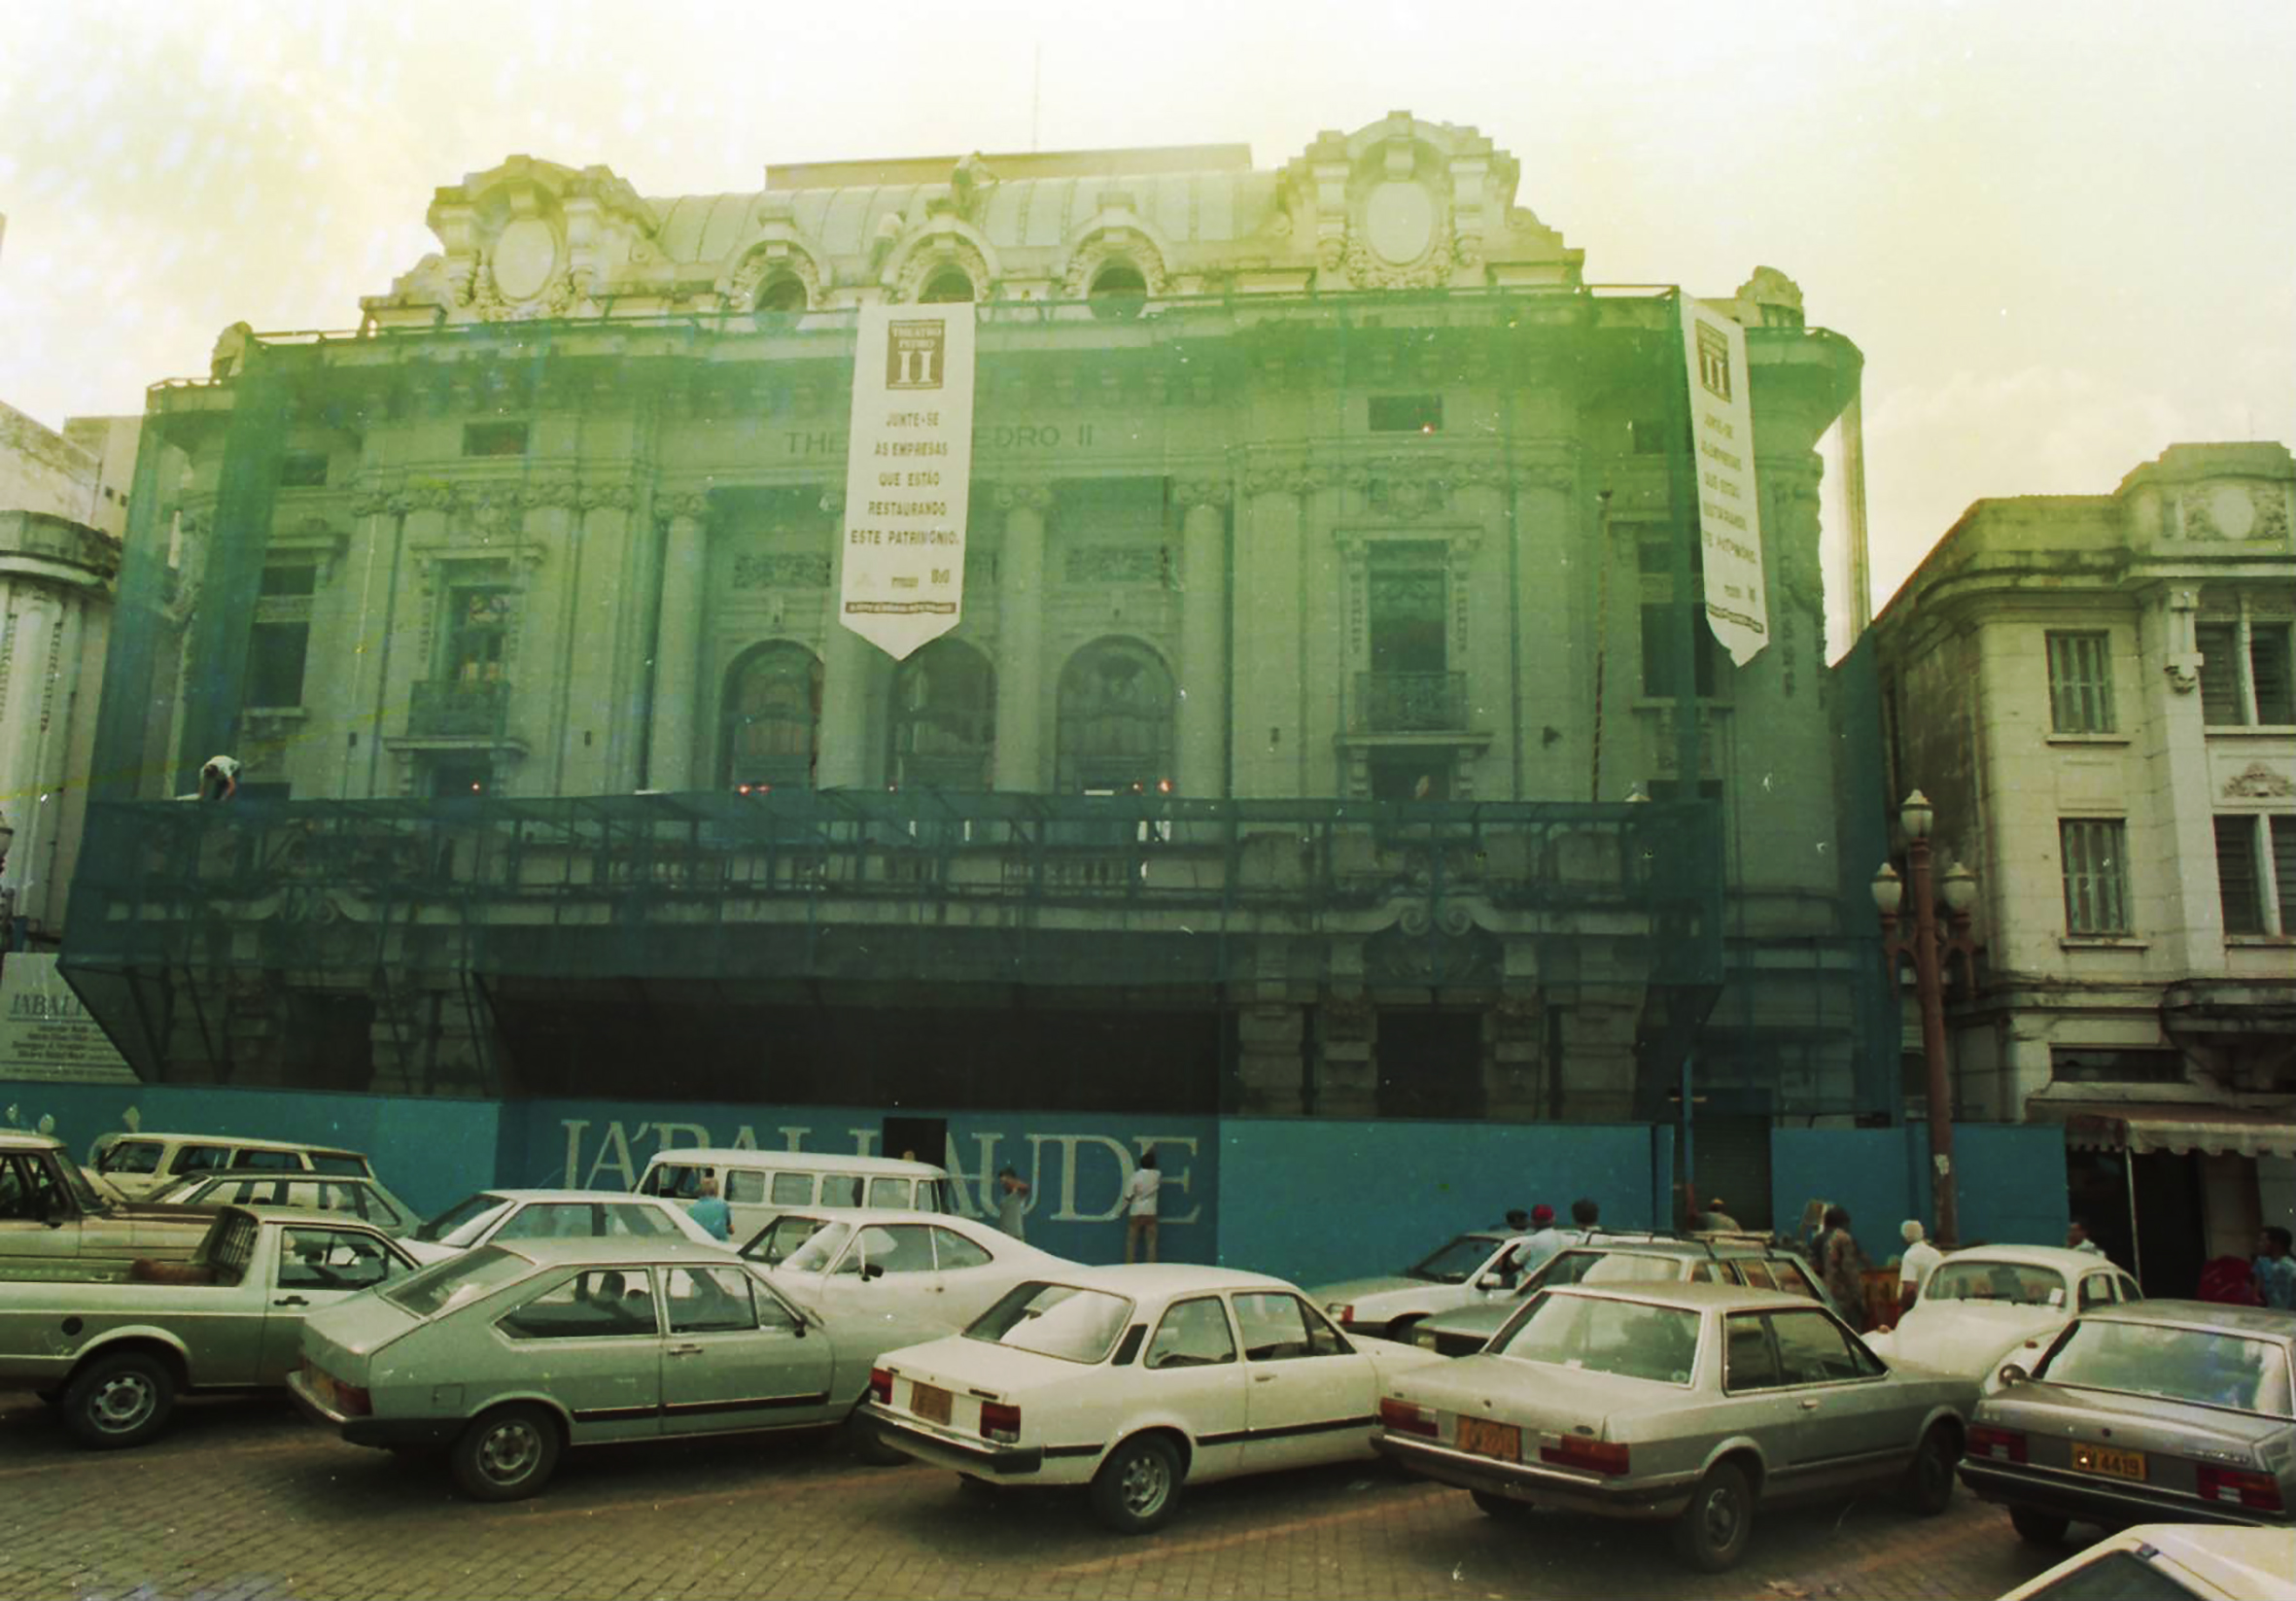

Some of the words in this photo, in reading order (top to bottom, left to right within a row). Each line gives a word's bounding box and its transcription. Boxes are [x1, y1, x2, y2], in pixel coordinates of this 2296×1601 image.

[897, 351, 935, 383] II
[971, 426, 1061, 449] EDRO
[878, 471, 900, 487] QUE
[867, 501, 948, 516] RESTAURANDO
[851, 530, 881, 544] ESTE
